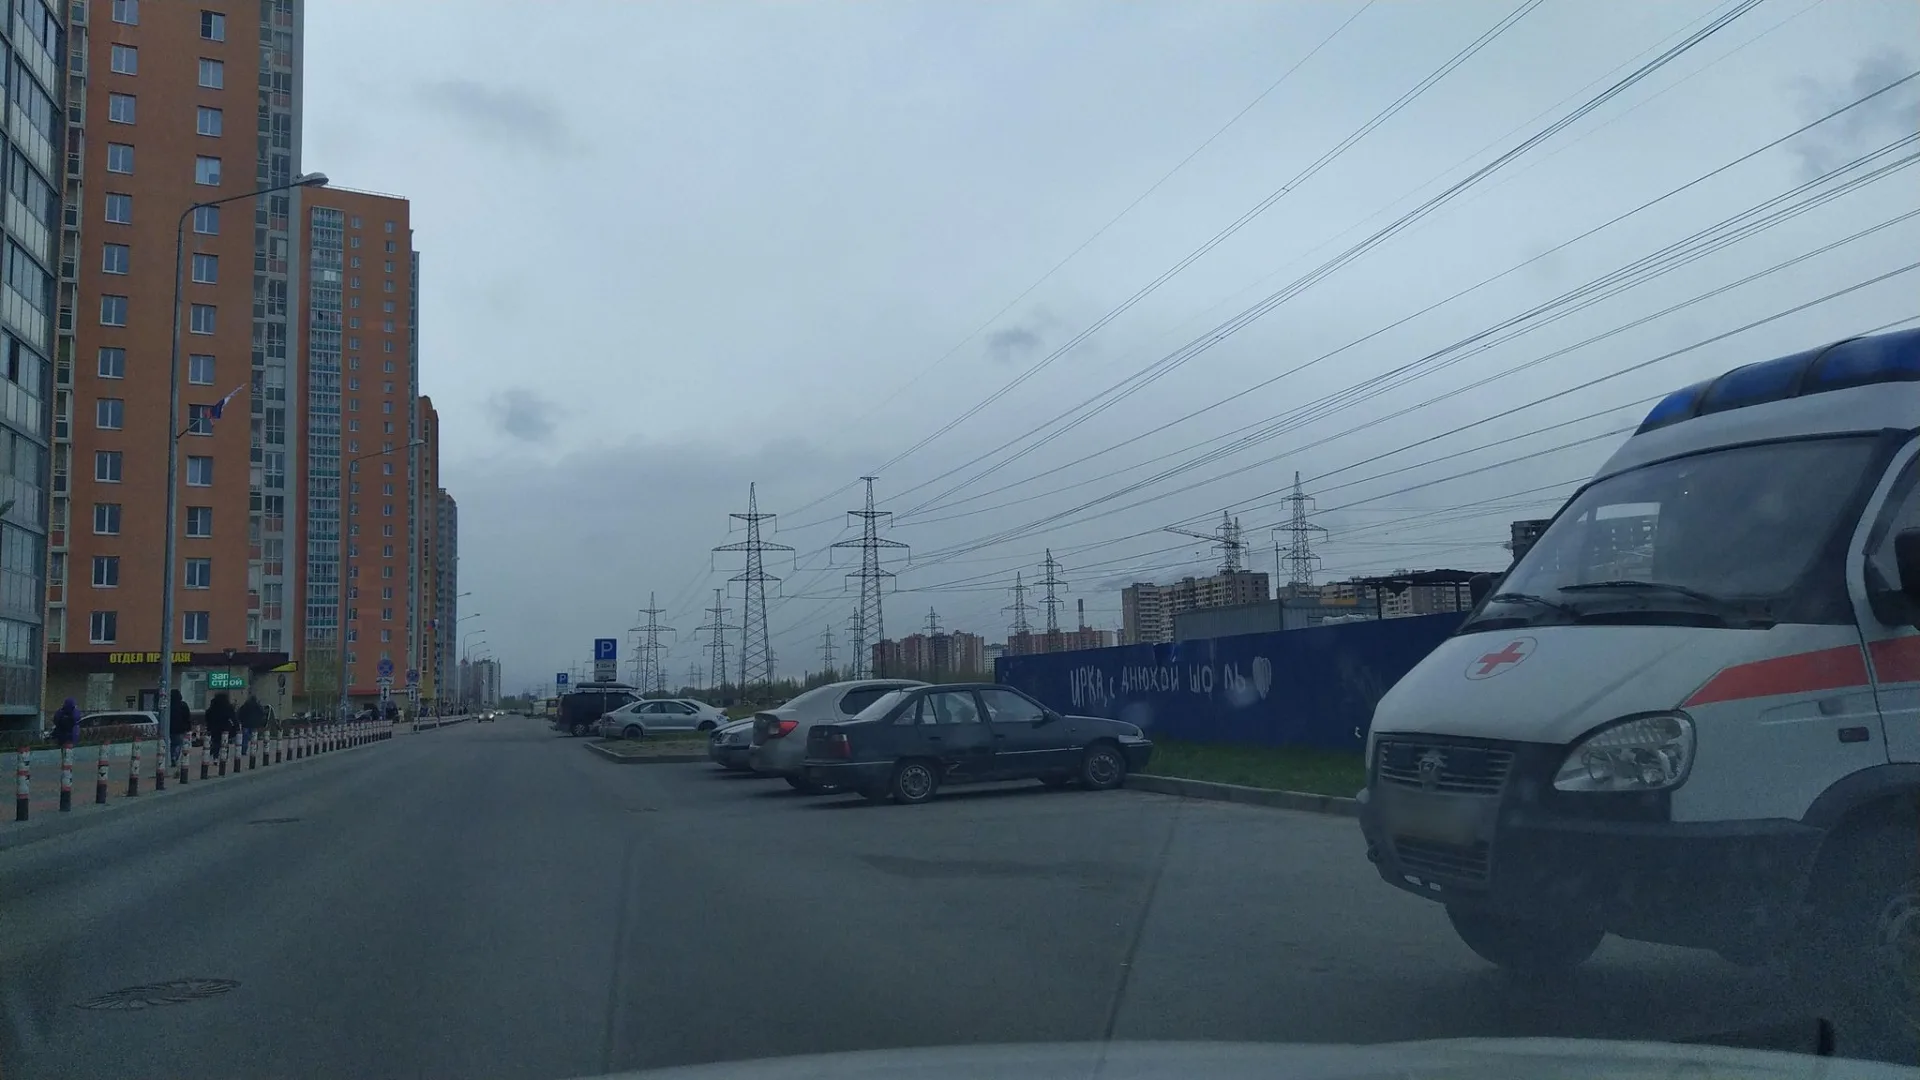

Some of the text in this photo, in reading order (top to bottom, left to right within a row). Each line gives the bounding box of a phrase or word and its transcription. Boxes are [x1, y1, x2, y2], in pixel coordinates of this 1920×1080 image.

[601, 641, 613, 657] P
[109, 652, 191, 664] ОТДЕЛ ПРАЖ
[211, 678, 243, 688] строй
[1070, 665, 1108, 708] ИРКА,
